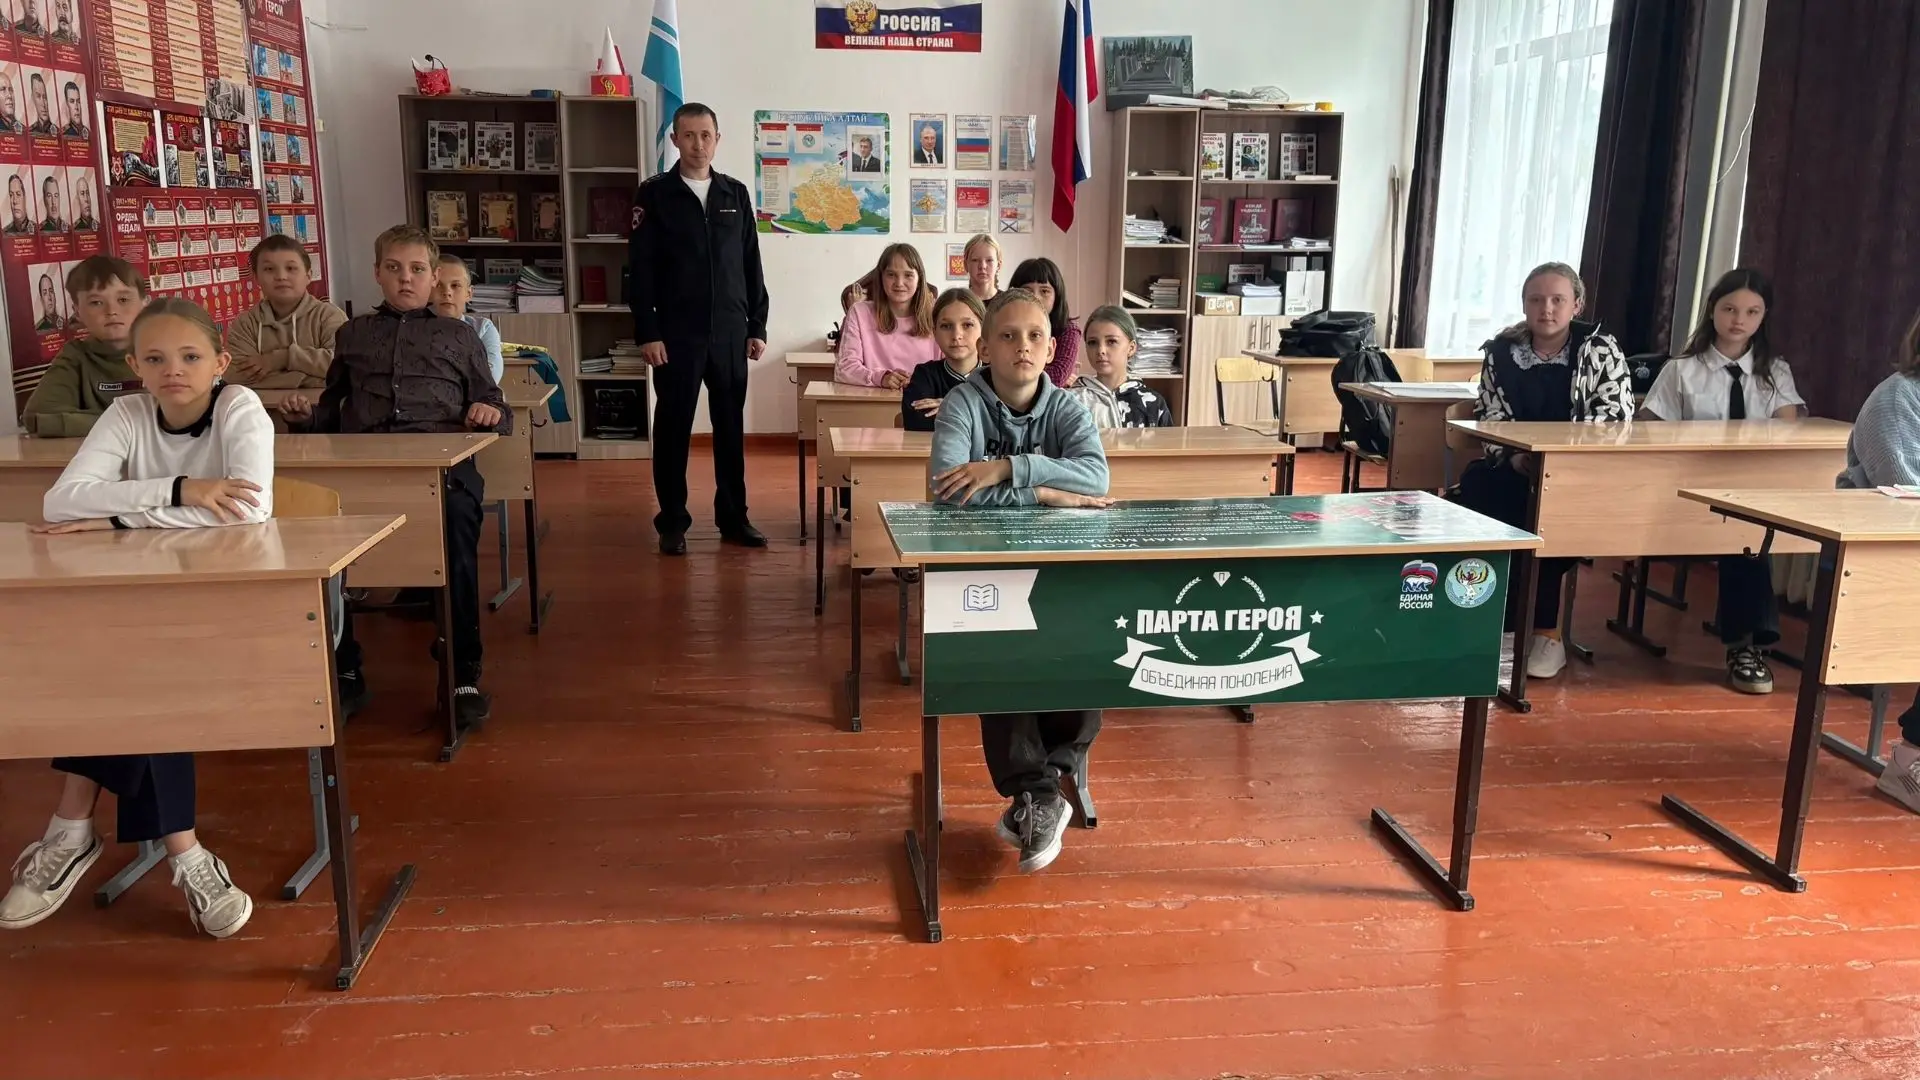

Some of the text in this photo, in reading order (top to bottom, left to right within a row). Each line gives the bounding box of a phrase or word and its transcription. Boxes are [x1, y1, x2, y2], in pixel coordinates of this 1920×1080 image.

[880, 15, 941, 31] РОССИЯ
[844, 35, 954, 48] ВЕЛИКАЯ НАША СТРАНА!
[1400, 593, 1434, 602] ЕДИНАЯ
[1399, 601, 1433, 609] РОССИЯ
[1136, 605, 1303, 634] ПАРТА ГЕРОЯ
[1220, 664, 1294, 690] ПОКОЛЕНИЯ
